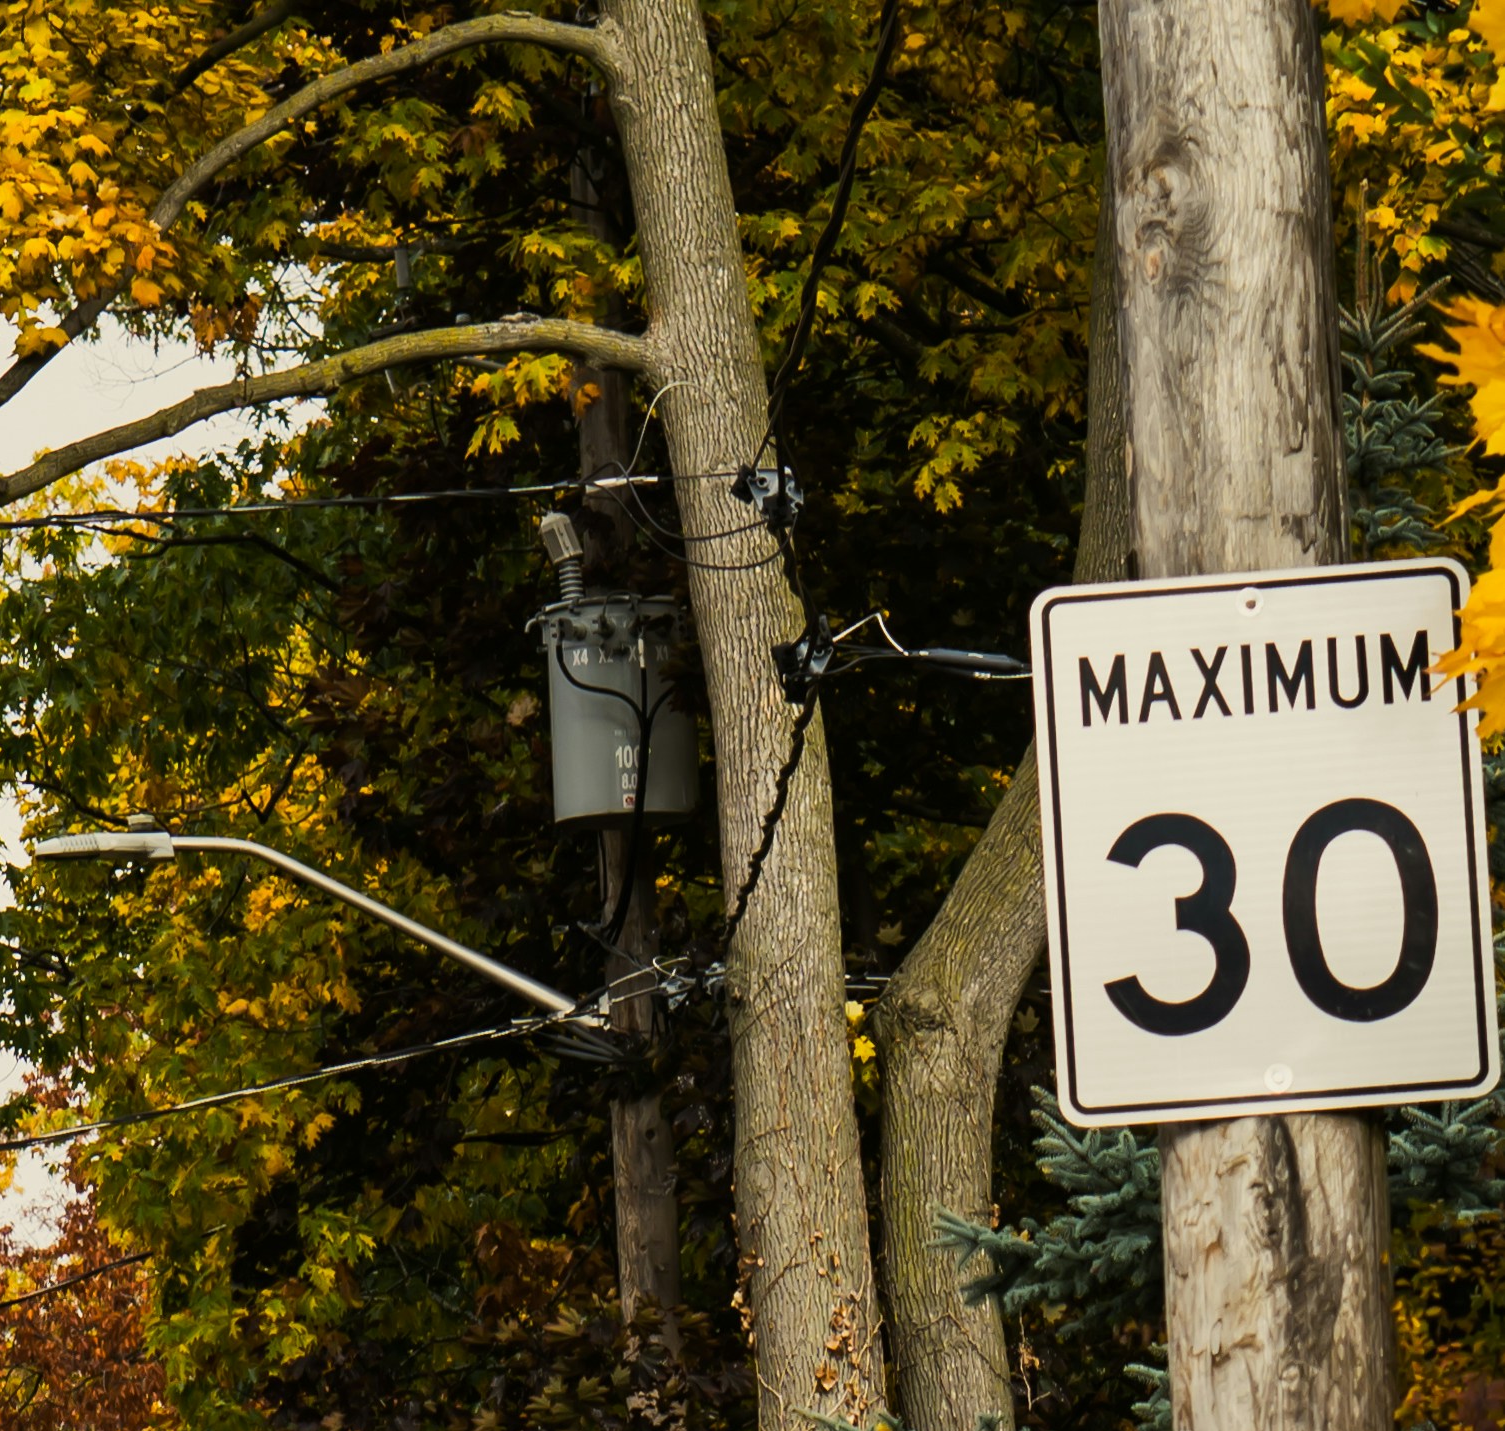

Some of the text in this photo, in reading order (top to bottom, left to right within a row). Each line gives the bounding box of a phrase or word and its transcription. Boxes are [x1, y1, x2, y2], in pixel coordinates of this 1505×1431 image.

[572, 648, 588, 666] X4
[1078, 630, 1432, 727] MAXIMUM
[1104, 798, 1438, 1036] 30
